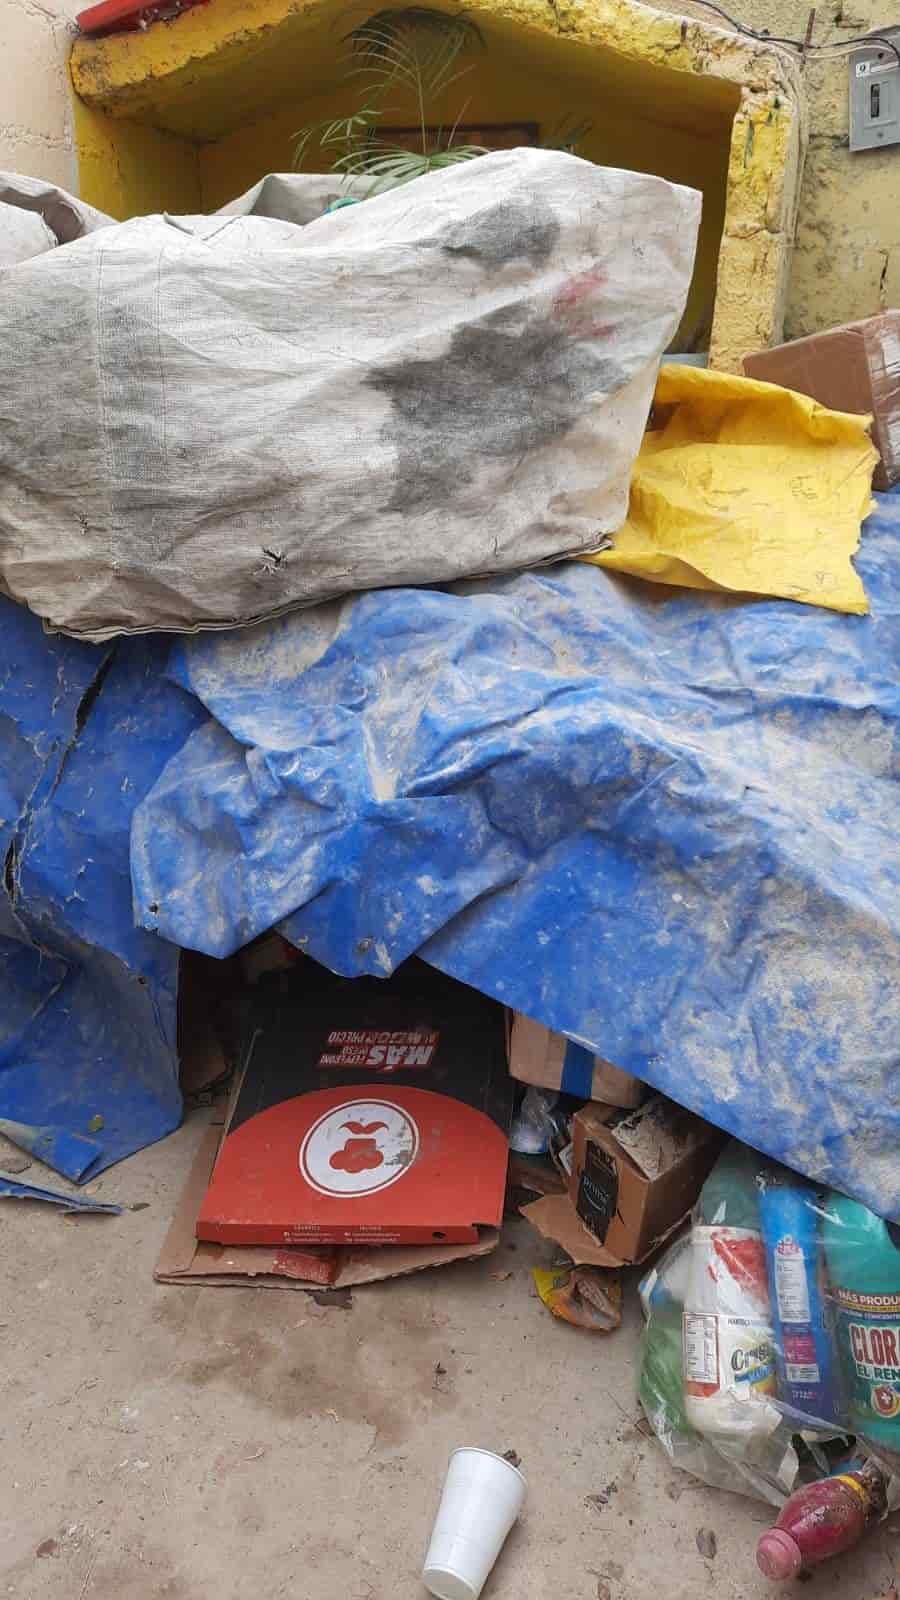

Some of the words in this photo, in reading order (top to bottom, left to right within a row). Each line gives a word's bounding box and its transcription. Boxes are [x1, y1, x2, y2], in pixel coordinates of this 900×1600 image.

[328, 1031, 366, 1044] PRECIO
[366, 1045, 433, 1071] MÁS
[857, 1366, 871, 1378] EL
